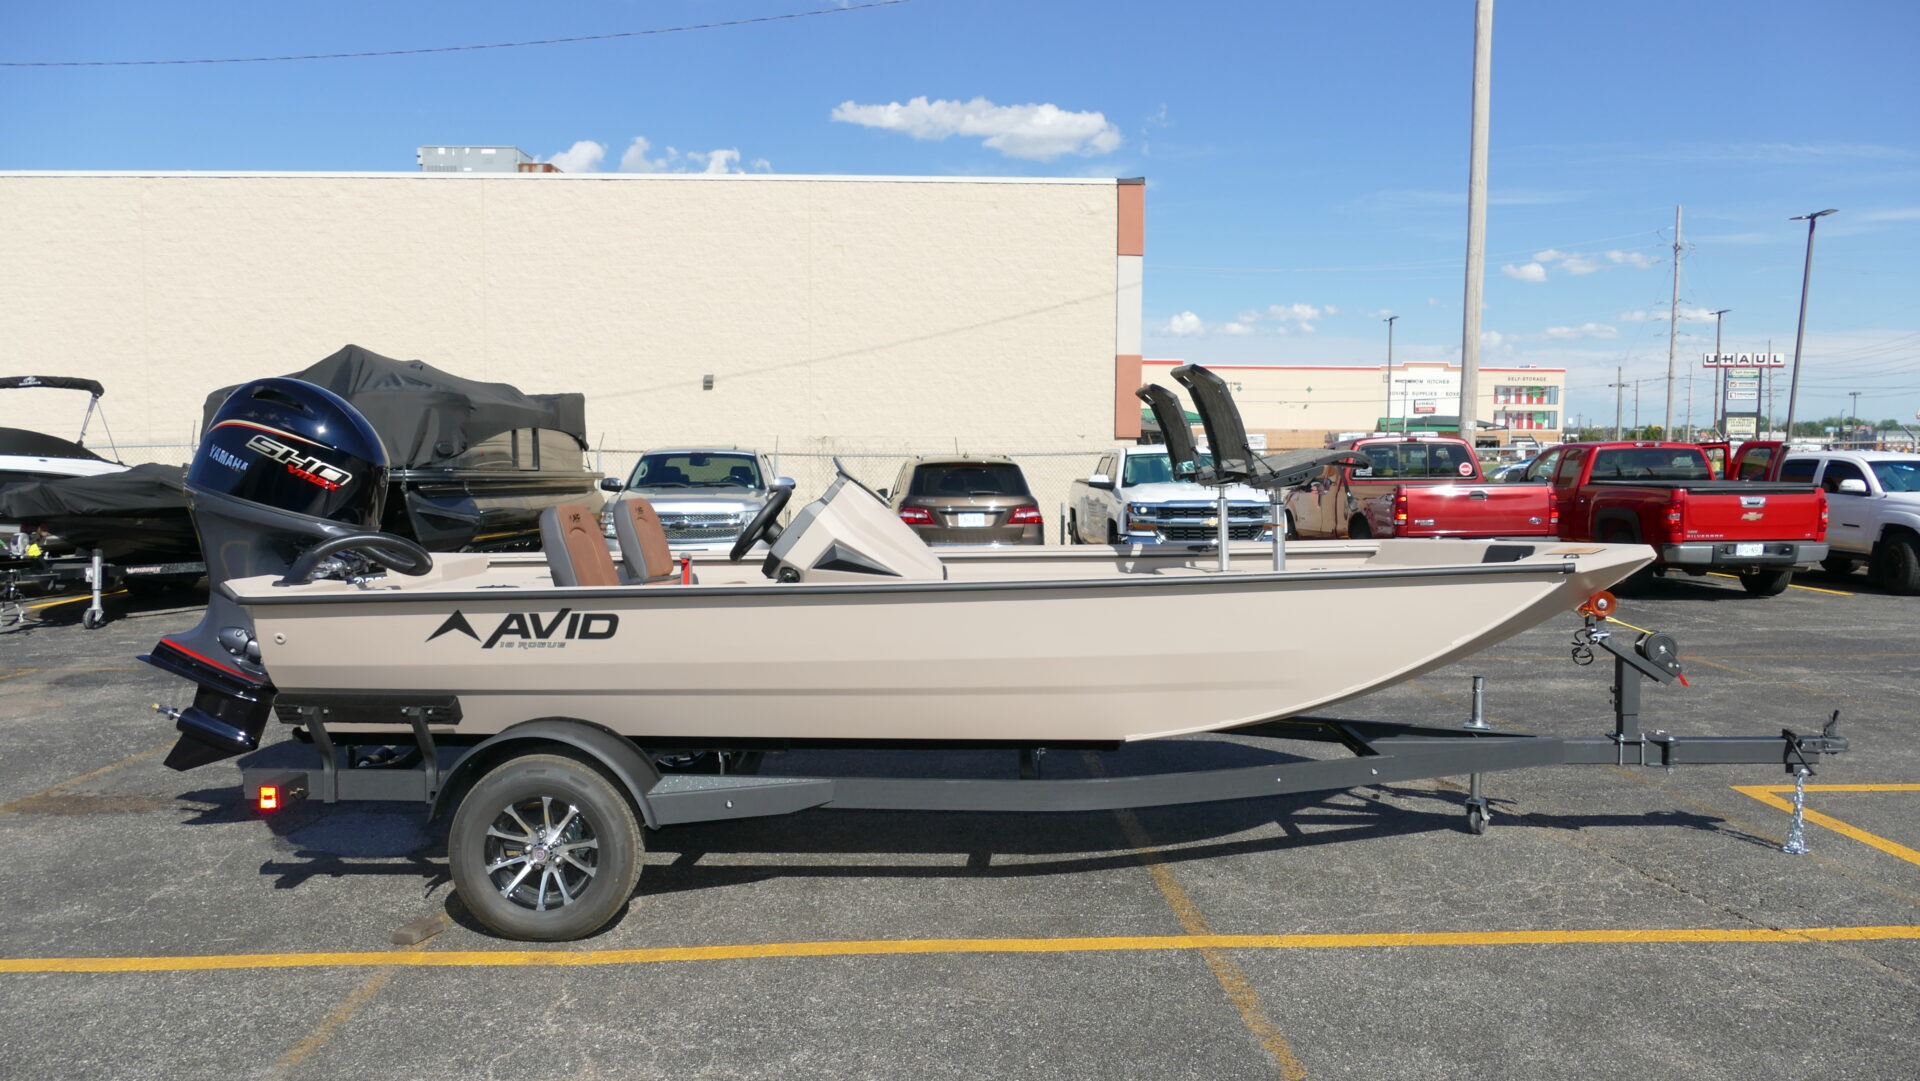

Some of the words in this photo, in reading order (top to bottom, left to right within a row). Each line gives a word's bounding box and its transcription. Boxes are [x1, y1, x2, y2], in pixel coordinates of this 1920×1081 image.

[207, 443, 249, 472] YAMAHA
[246, 435, 352, 486] SHO
[481, 608, 619, 649] AVID
